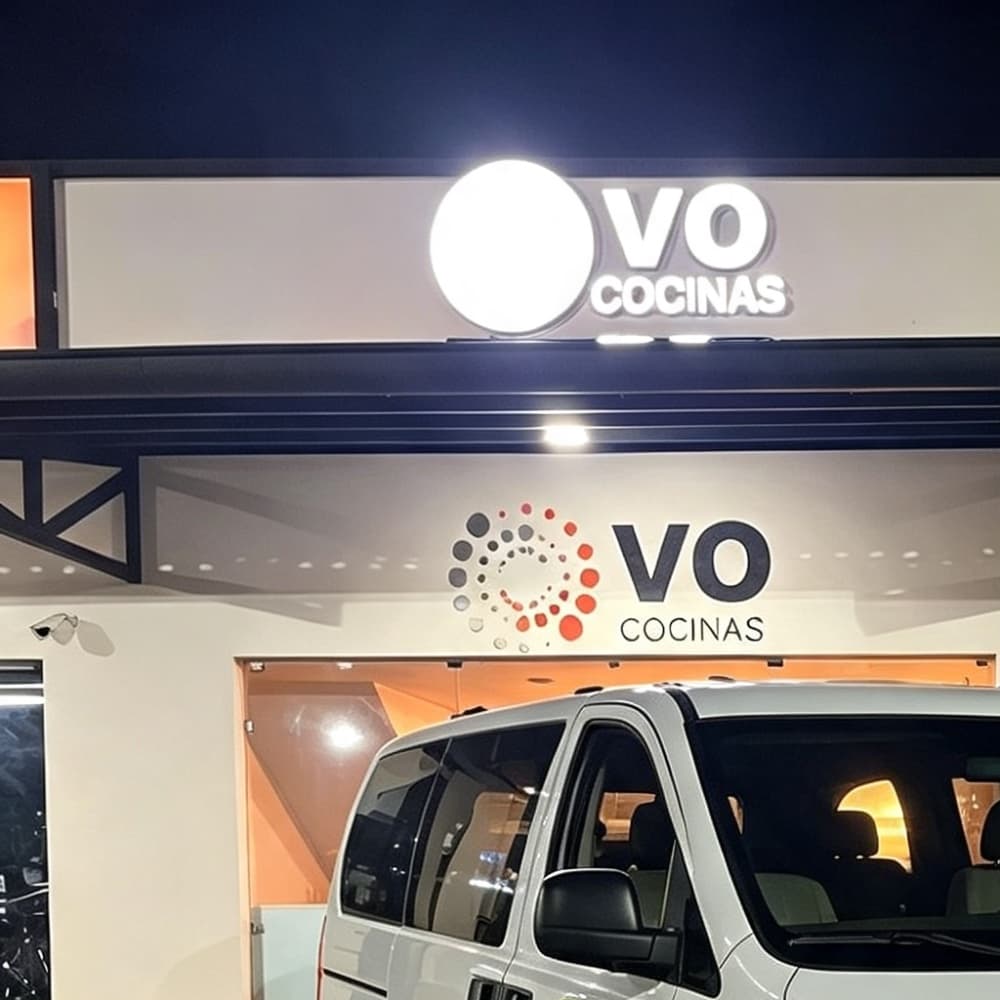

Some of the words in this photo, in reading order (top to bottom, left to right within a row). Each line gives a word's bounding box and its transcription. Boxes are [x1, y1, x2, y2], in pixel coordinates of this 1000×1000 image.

[601, 182, 768, 270] VO
[590, 274, 787, 315] COCINAS
[611, 520, 771, 602] VO
[620, 617, 764, 642] COCINAS
